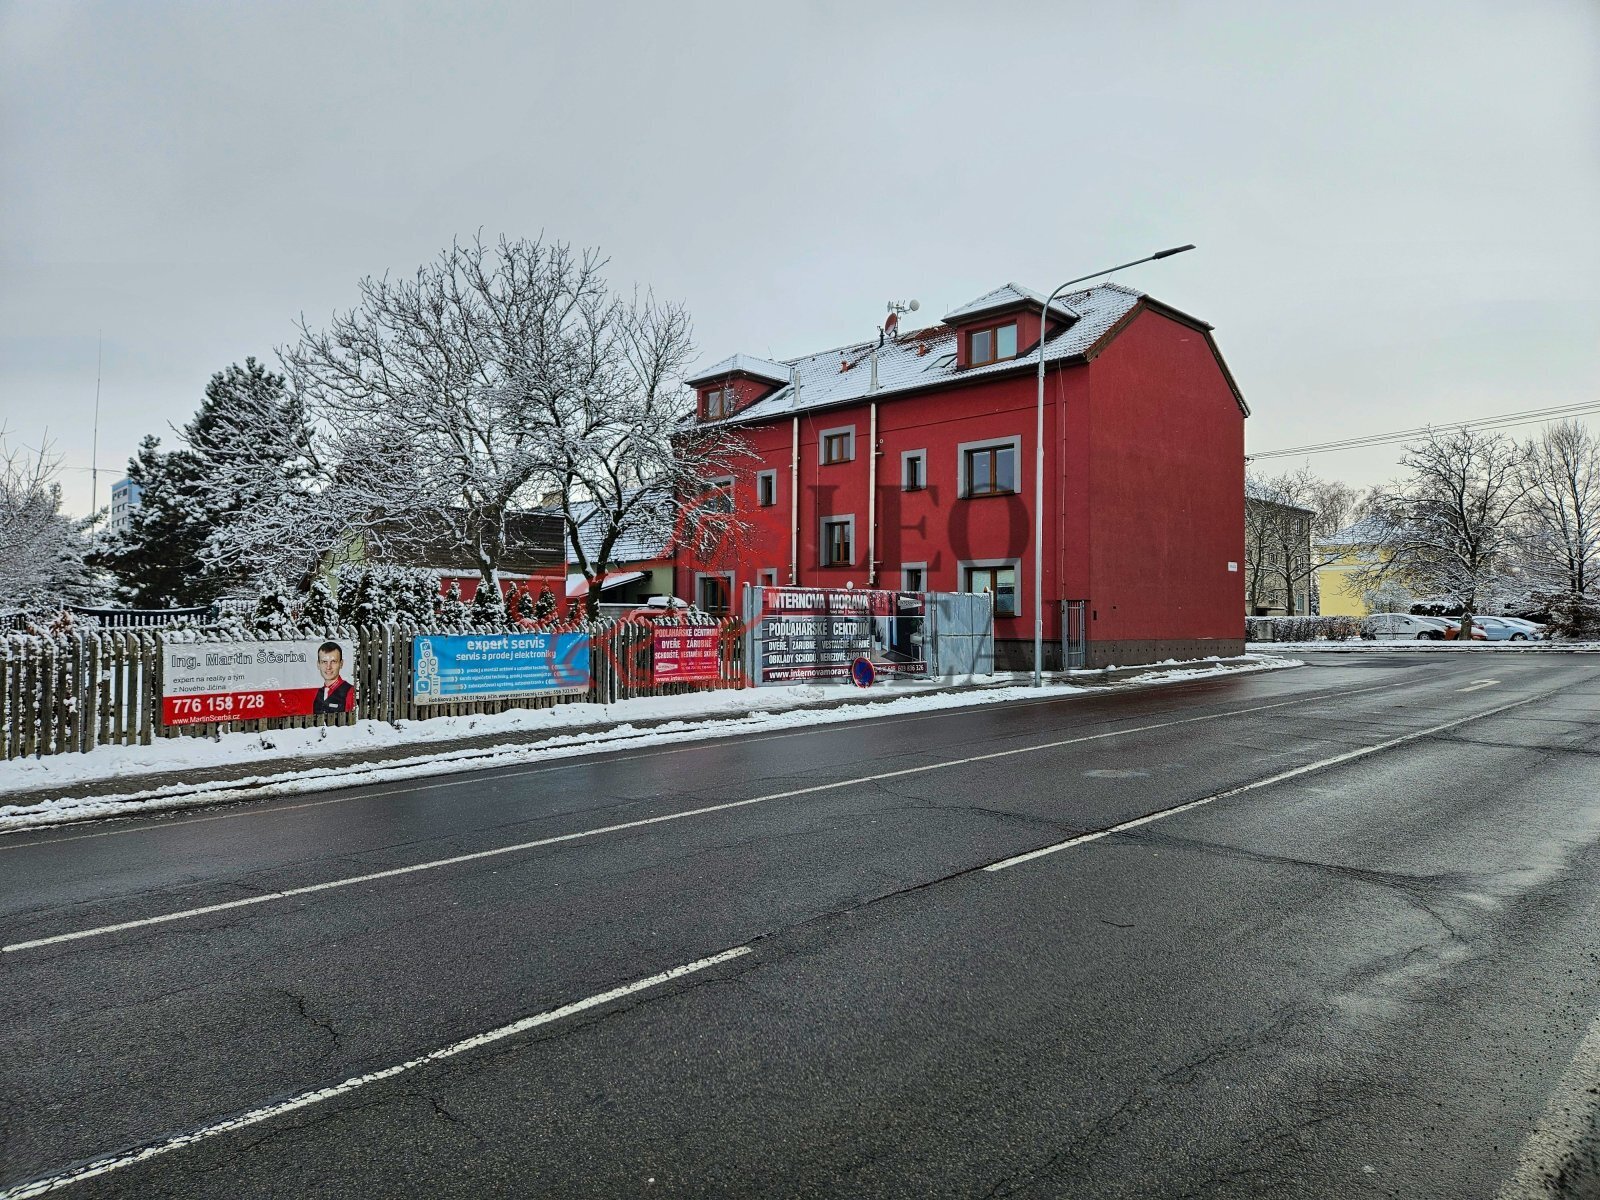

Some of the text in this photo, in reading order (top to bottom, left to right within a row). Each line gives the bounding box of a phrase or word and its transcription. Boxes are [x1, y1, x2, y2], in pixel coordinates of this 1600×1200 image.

[769, 592, 869, 610] INTERNOVA MORAVA
[655, 626, 718, 638] PODLAHÁŘSKÉ CENTRUM
[769, 618, 870, 637] PODLAHÁŘSKÉ CENTRUM
[467, 637, 546, 652] expert servis
[661, 637, 682, 649] DVEŘE
[769, 636, 788, 651] DVEŘE,
[172, 648, 307, 670] Ing. Martin Ščerba
[456, 649, 557, 662] servis a prodej elektroniky
[769, 653, 794, 665] OBKLADY
[173, 677, 195, 686] expert
[195, 676, 205, 684] na
[206, 674, 226, 684] reality
[233, 674, 245, 683] tým
[178, 684, 206, 694] Nového
[206, 683, 227, 693] Jičína
[172, 694, 265, 714] 776 158 728
[172, 713, 241, 726] www.MartinScerba.cz
